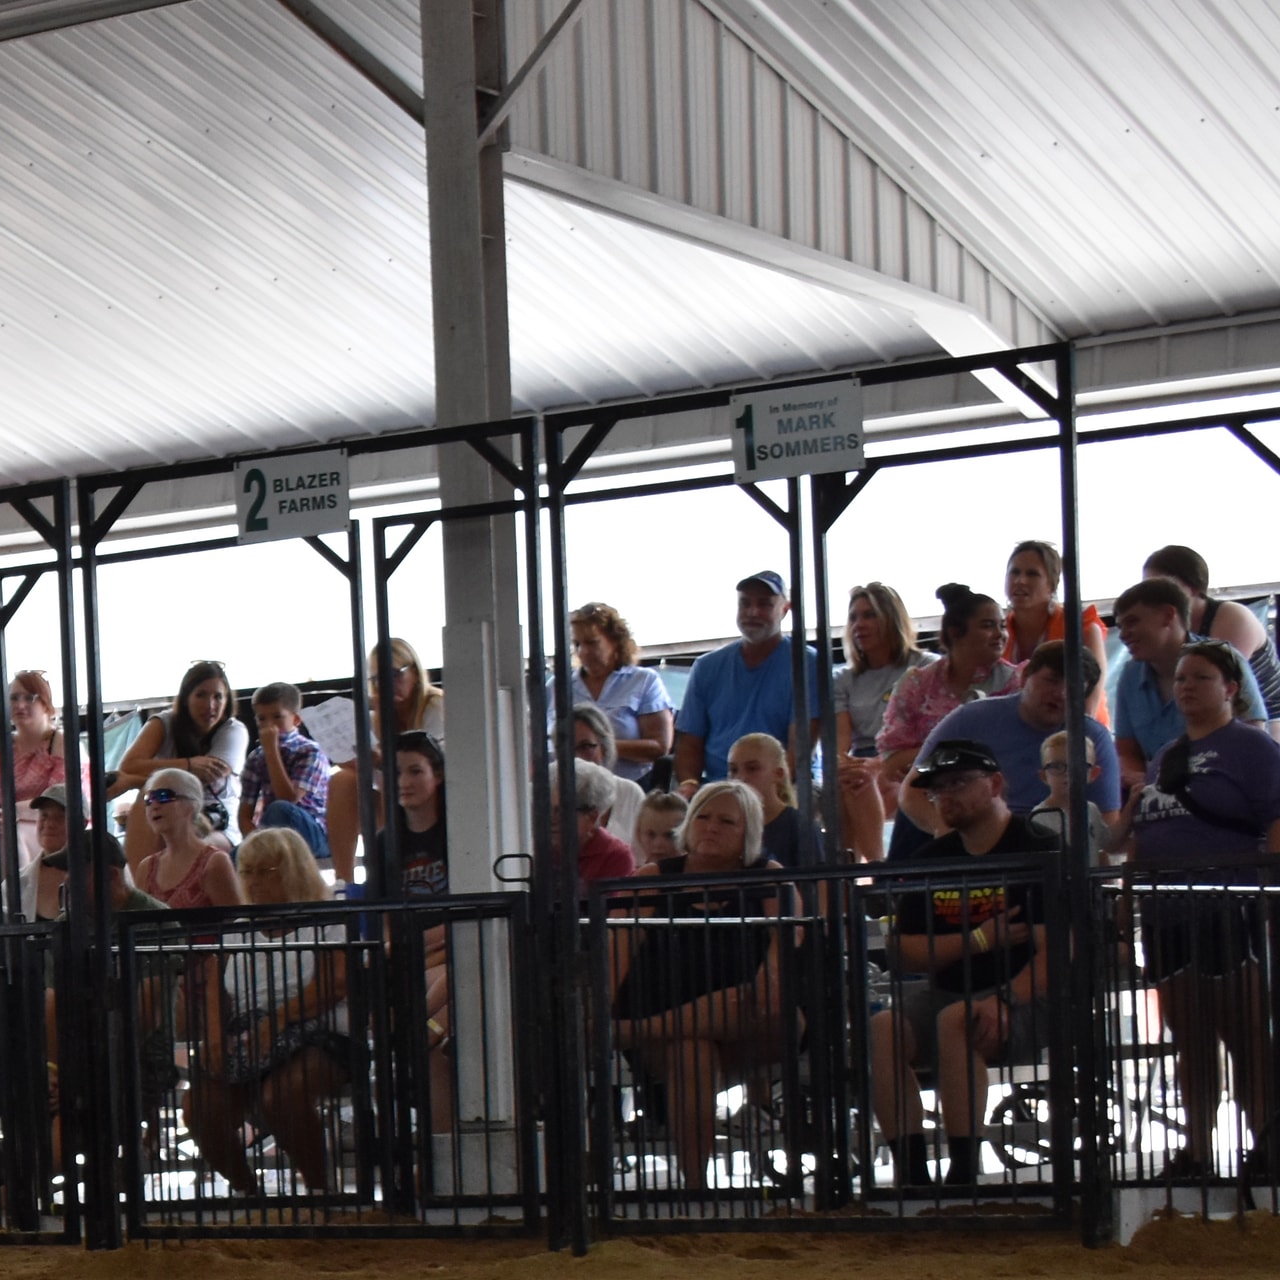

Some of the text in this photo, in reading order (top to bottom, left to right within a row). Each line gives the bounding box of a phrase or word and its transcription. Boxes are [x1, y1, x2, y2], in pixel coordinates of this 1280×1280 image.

[770, 397, 838, 414] In Memory of
[778, 412, 836, 434] MARK
[736, 404, 756, 471] 1
[756, 433, 859, 461] SOMMERS
[274, 471, 340, 493] BLAZER
[243, 468, 268, 532] 2
[279, 494, 337, 515] FARMS
